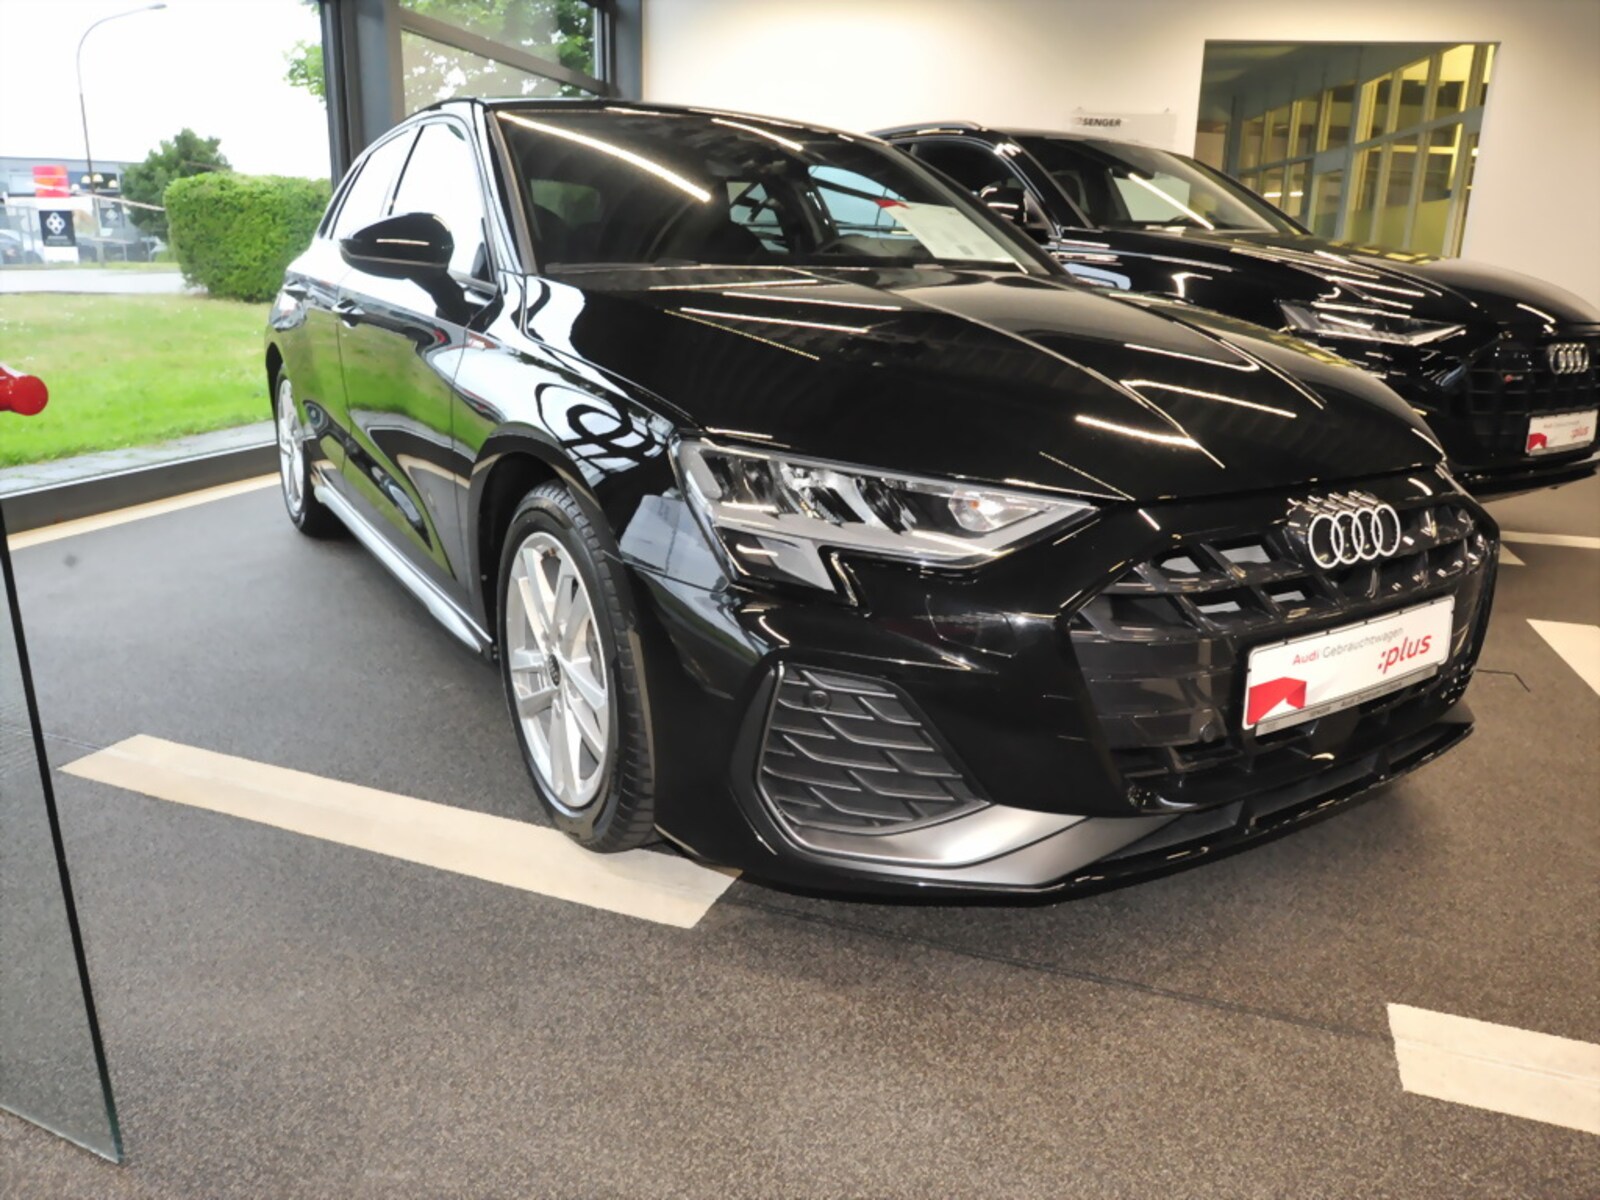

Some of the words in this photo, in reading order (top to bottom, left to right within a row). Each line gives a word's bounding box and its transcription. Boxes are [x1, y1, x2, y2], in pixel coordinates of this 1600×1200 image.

[1082, 118, 1122, 127] SENGER
[1292, 649, 1320, 665] Audi
[1322, 627, 1405, 658] Gebrauchtwagen
[1377, 634, 1432, 674] :plus
